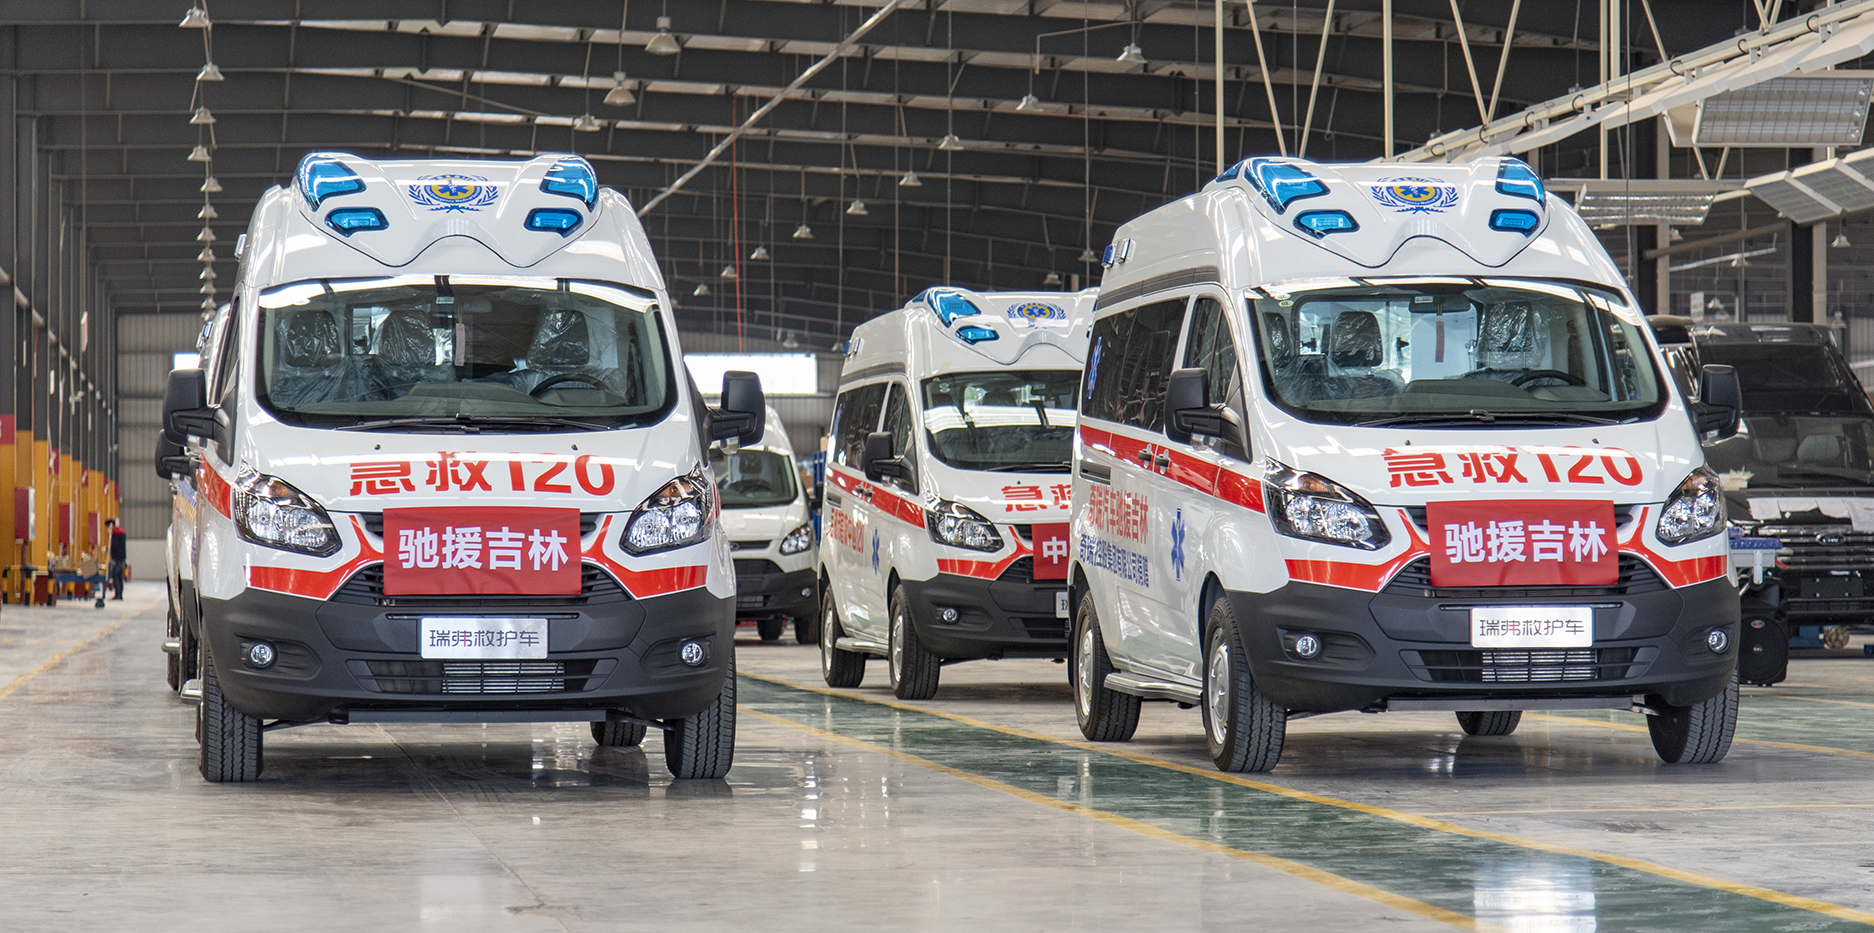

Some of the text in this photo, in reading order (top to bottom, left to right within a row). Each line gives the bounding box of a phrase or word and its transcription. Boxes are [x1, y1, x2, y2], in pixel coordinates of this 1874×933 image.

[349, 450, 616, 496] 急救120
[1381, 444, 1644, 488] 急救120
[1084, 482, 1149, 545] 奇瑞汽车驰援吉林
[397, 525, 569, 572] 驰援吉林
[1043, 536, 1067, 564] 中
[1444, 519, 1609, 564] 驰援吉林
[429, 629, 541, 647] 瑞弗救护车
[1479, 619, 1585, 636] 瑞弗救护车
